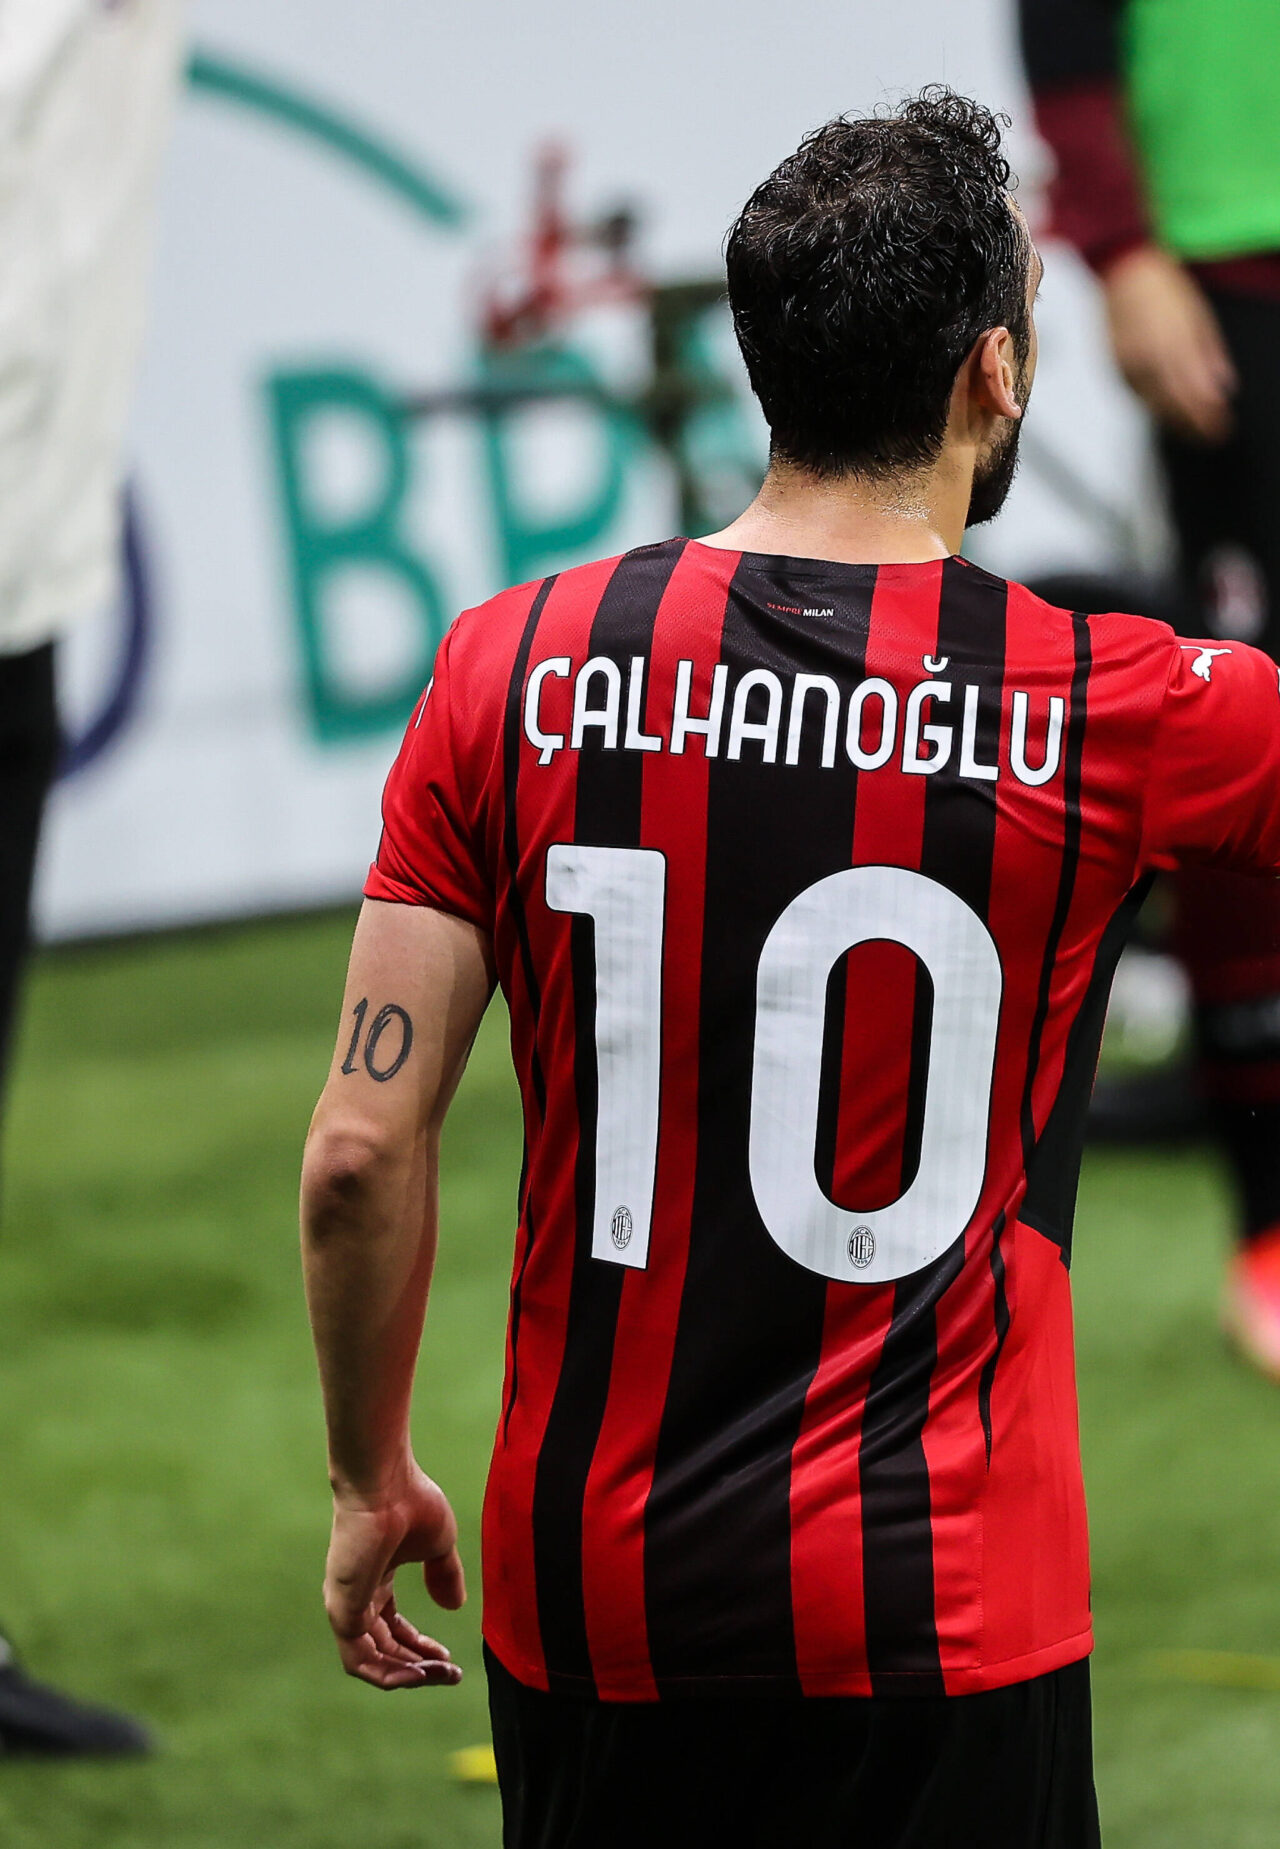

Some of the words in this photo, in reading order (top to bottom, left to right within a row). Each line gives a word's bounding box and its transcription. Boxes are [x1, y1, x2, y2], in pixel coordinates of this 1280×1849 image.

[262, 305, 765, 745] BP
[524, 655, 1065, 786] ÇALHANOĞLU
[341, 997, 413, 1082] 10
[546, 843, 1003, 1284] 10
